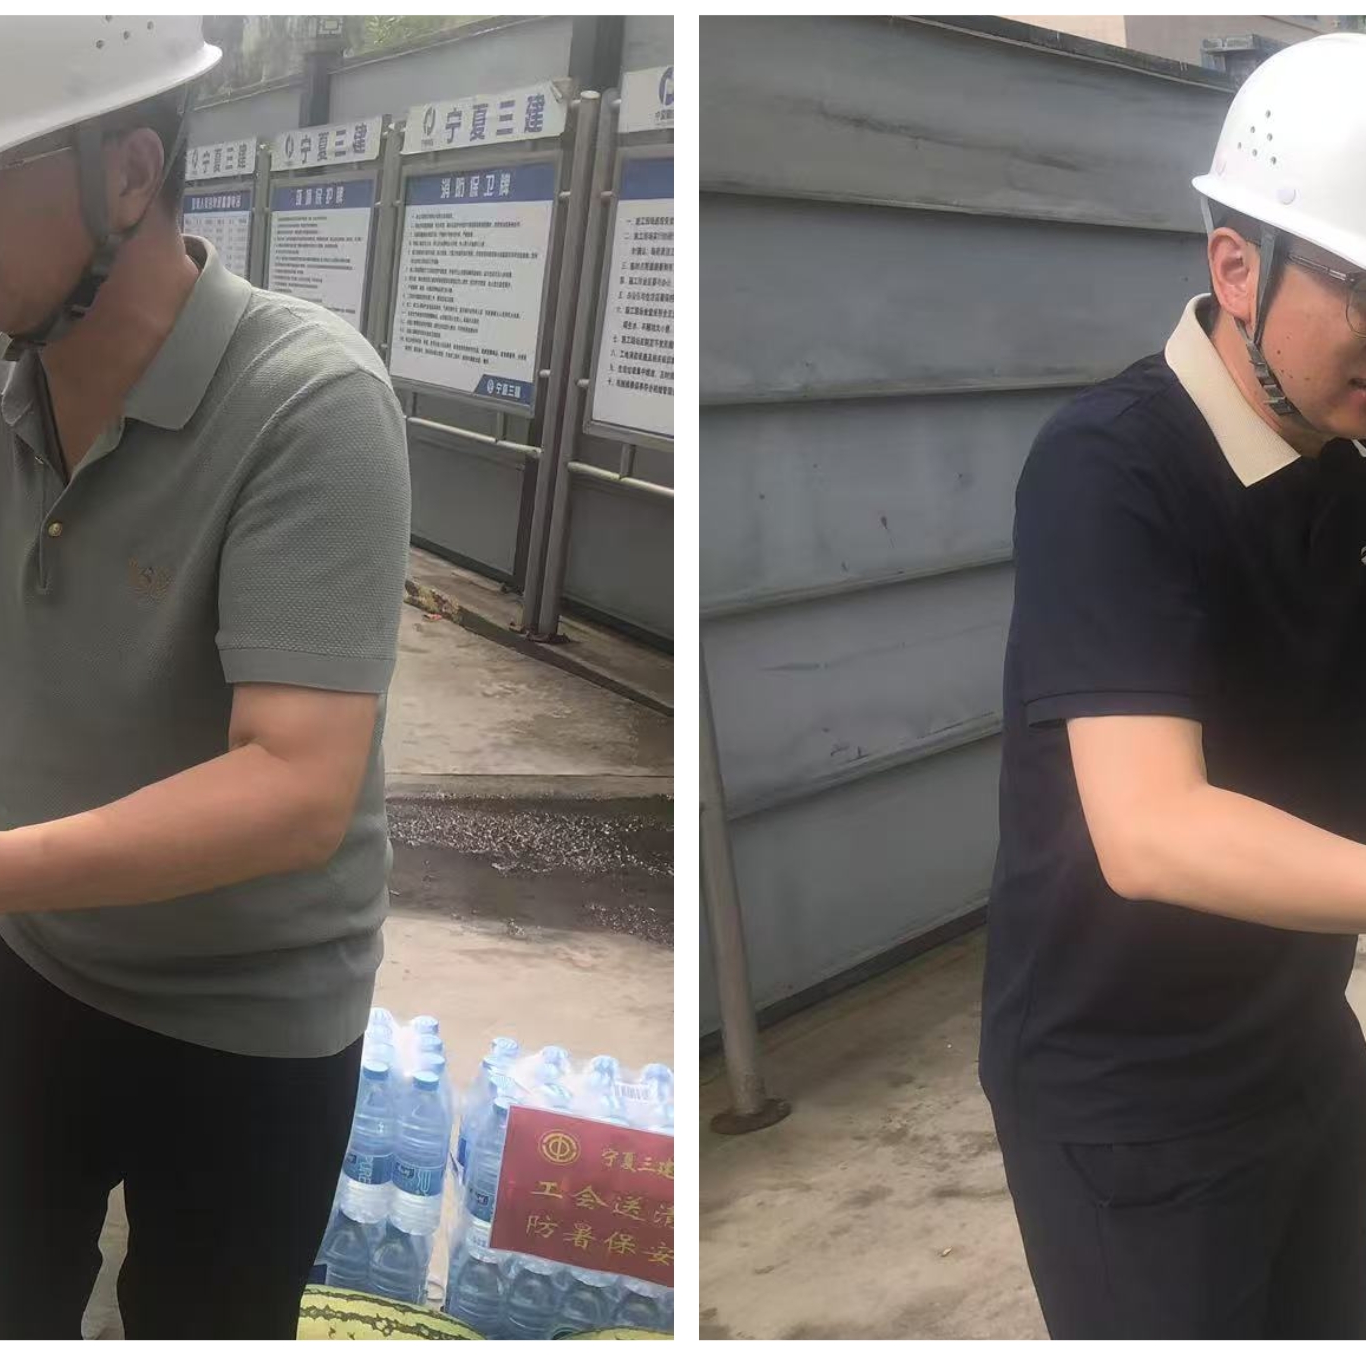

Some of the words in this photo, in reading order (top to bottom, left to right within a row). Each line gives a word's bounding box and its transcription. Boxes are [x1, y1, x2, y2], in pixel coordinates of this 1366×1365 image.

[300, 122, 368, 164] 宁夏三建
[444, 94, 546, 144] 宁夏三建
[525, 1214, 674, 1267] 防暑保安
